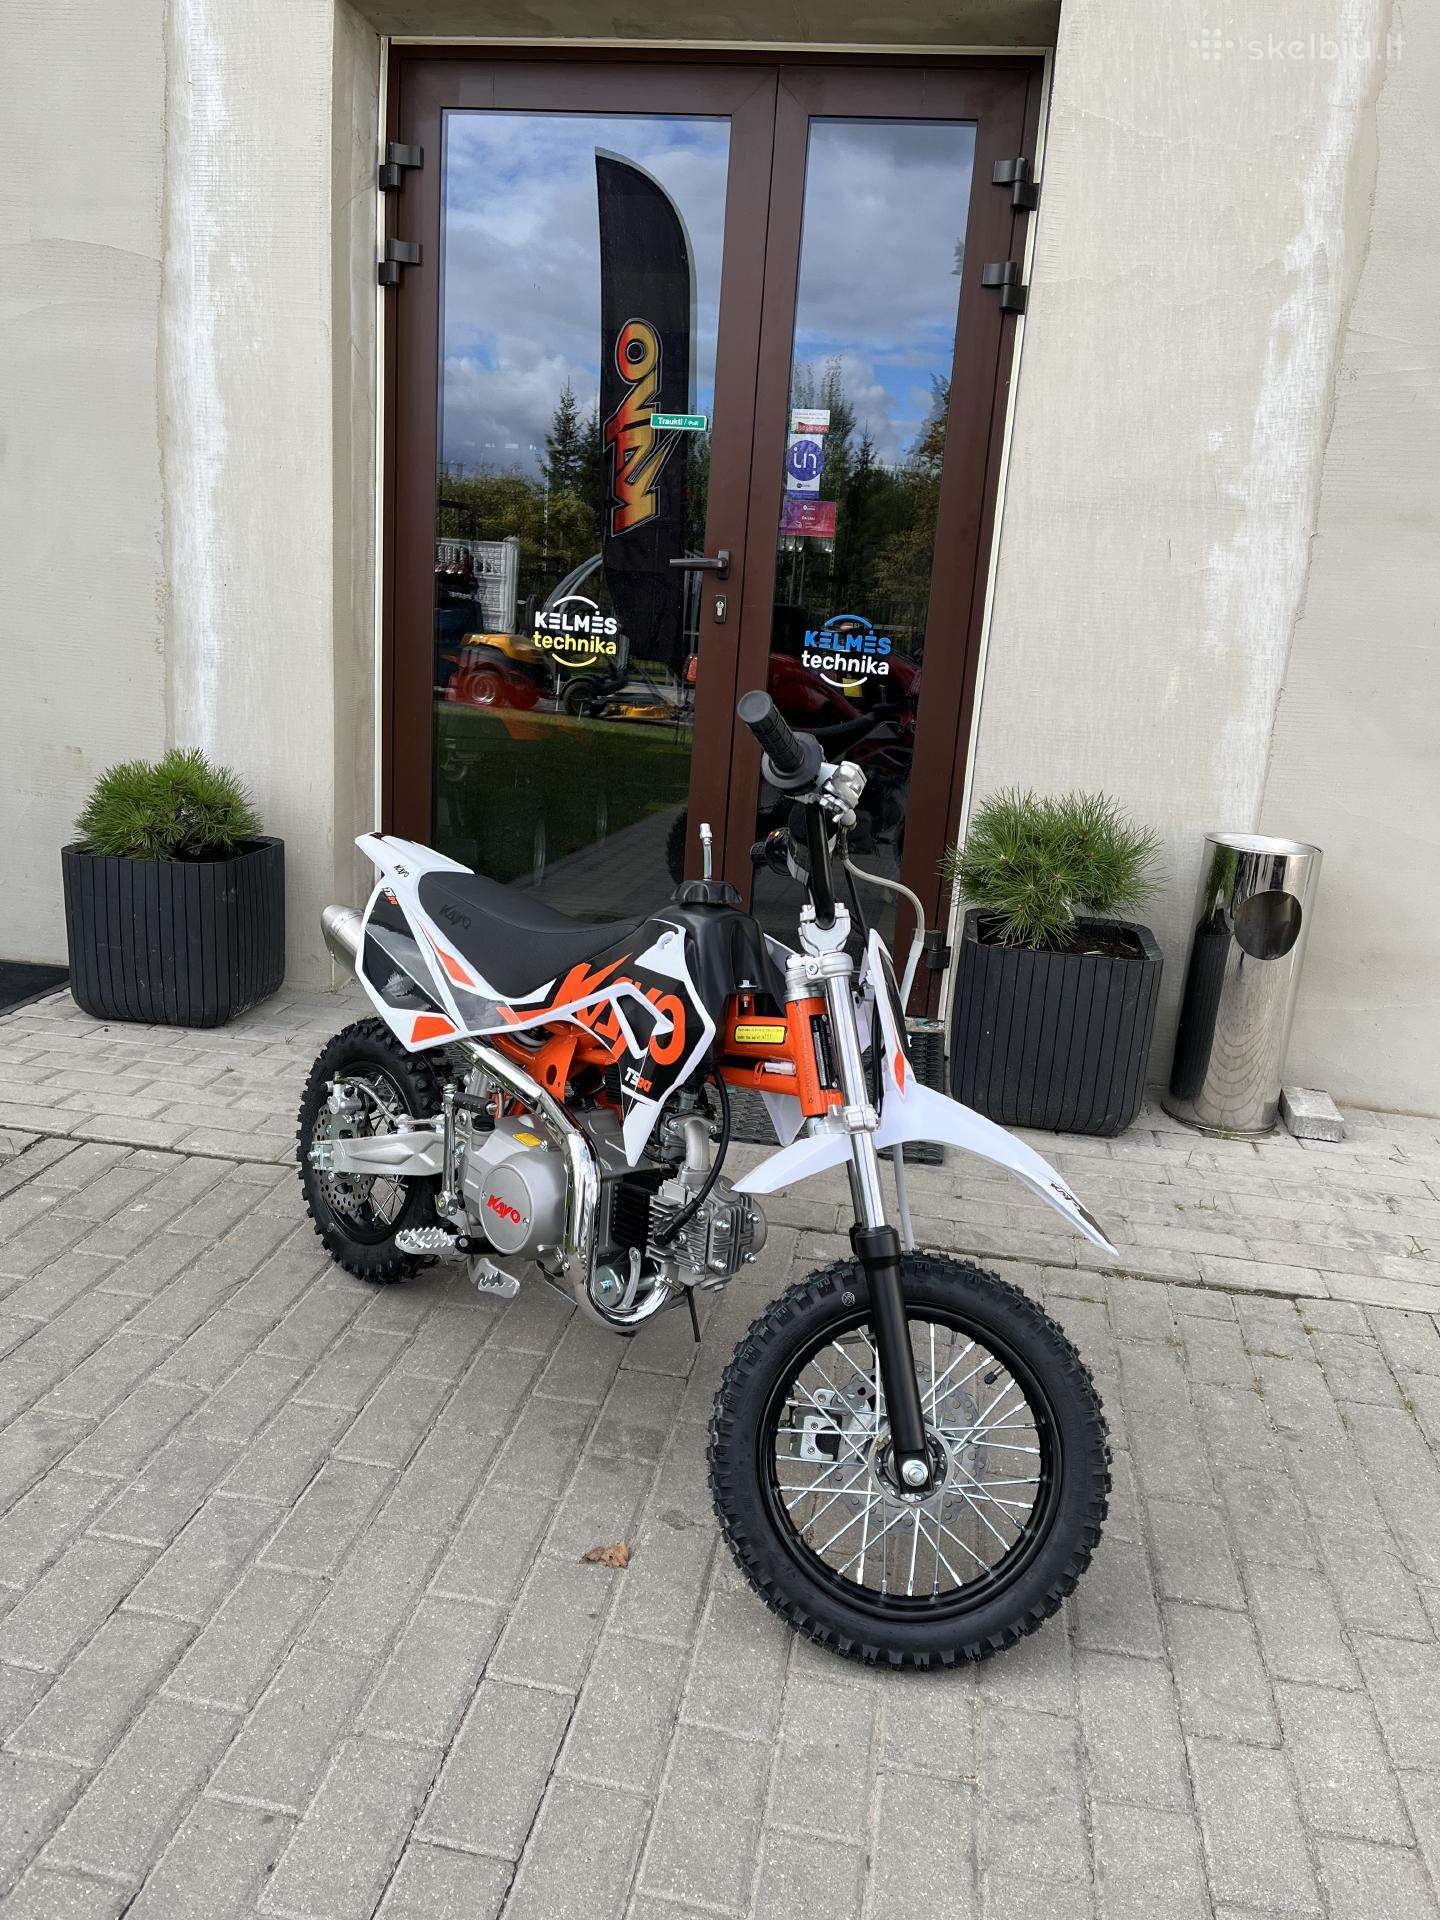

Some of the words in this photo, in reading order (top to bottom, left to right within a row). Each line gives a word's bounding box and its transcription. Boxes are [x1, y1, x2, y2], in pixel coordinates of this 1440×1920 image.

[658, 417, 683, 426] Traukti
[534, 610, 618, 635] KELMĖS
[533, 632, 617, 656] technika
[804, 629, 892, 655] KELMĖS
[801, 651, 890, 676] technika
